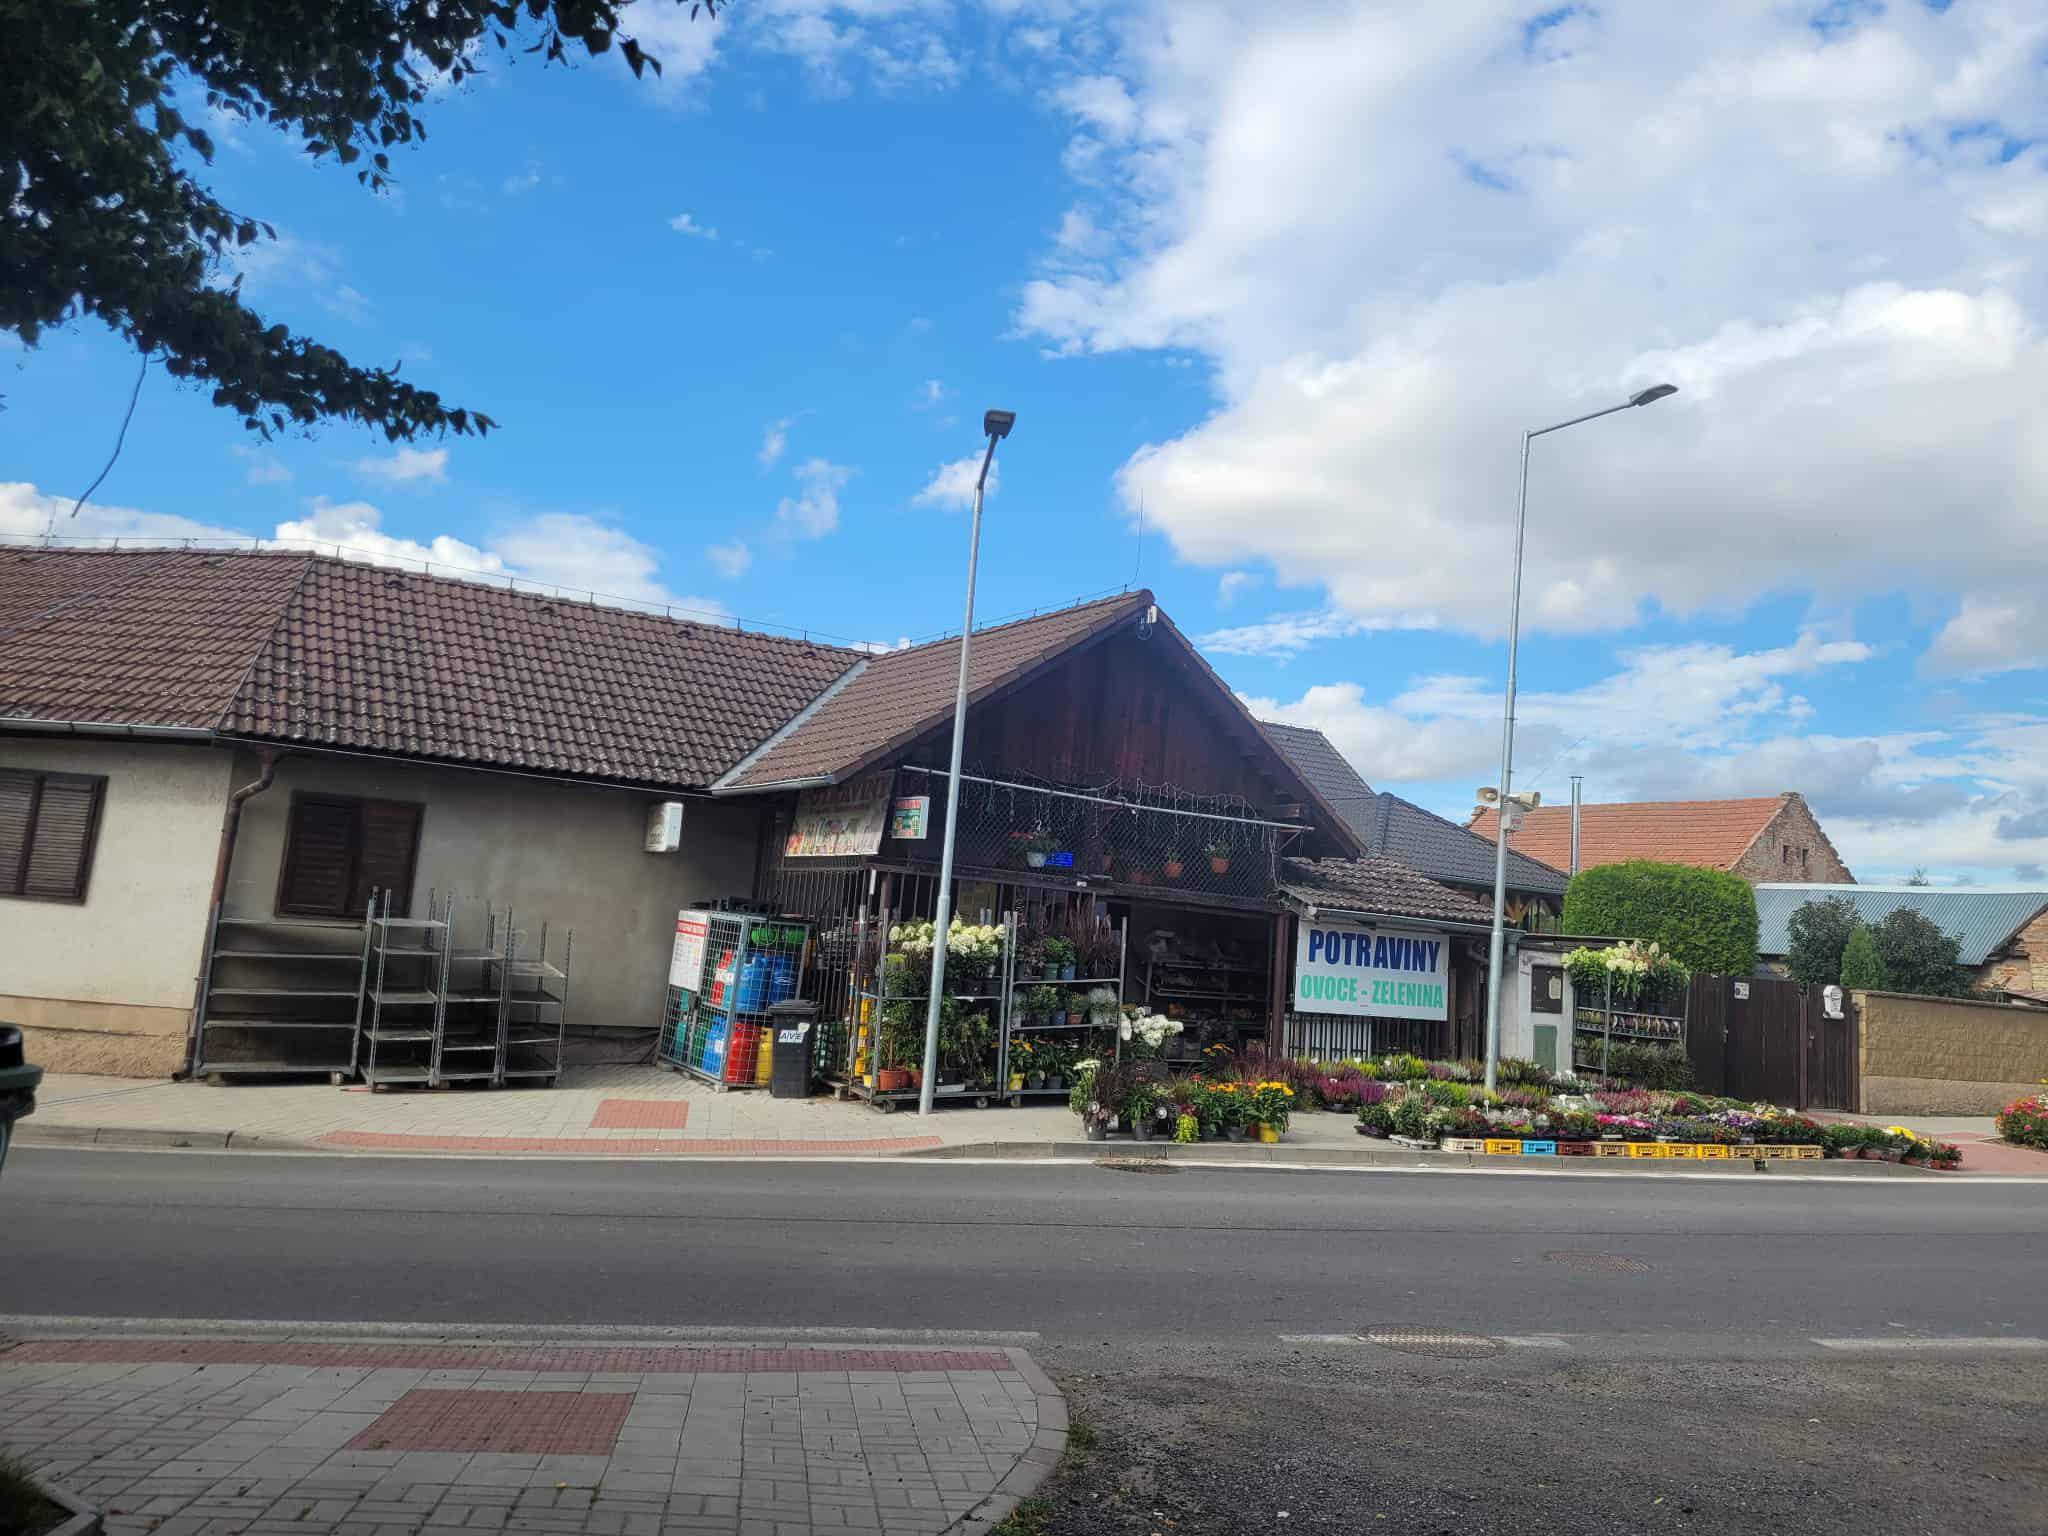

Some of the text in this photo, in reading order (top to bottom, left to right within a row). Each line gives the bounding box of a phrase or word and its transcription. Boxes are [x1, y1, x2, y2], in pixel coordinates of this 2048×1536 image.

[1308, 929, 1440, 973] POTRAVINY
[1301, 974, 1357, 1001] OVOCE
[1371, 980, 1443, 1008] ZELENINA
